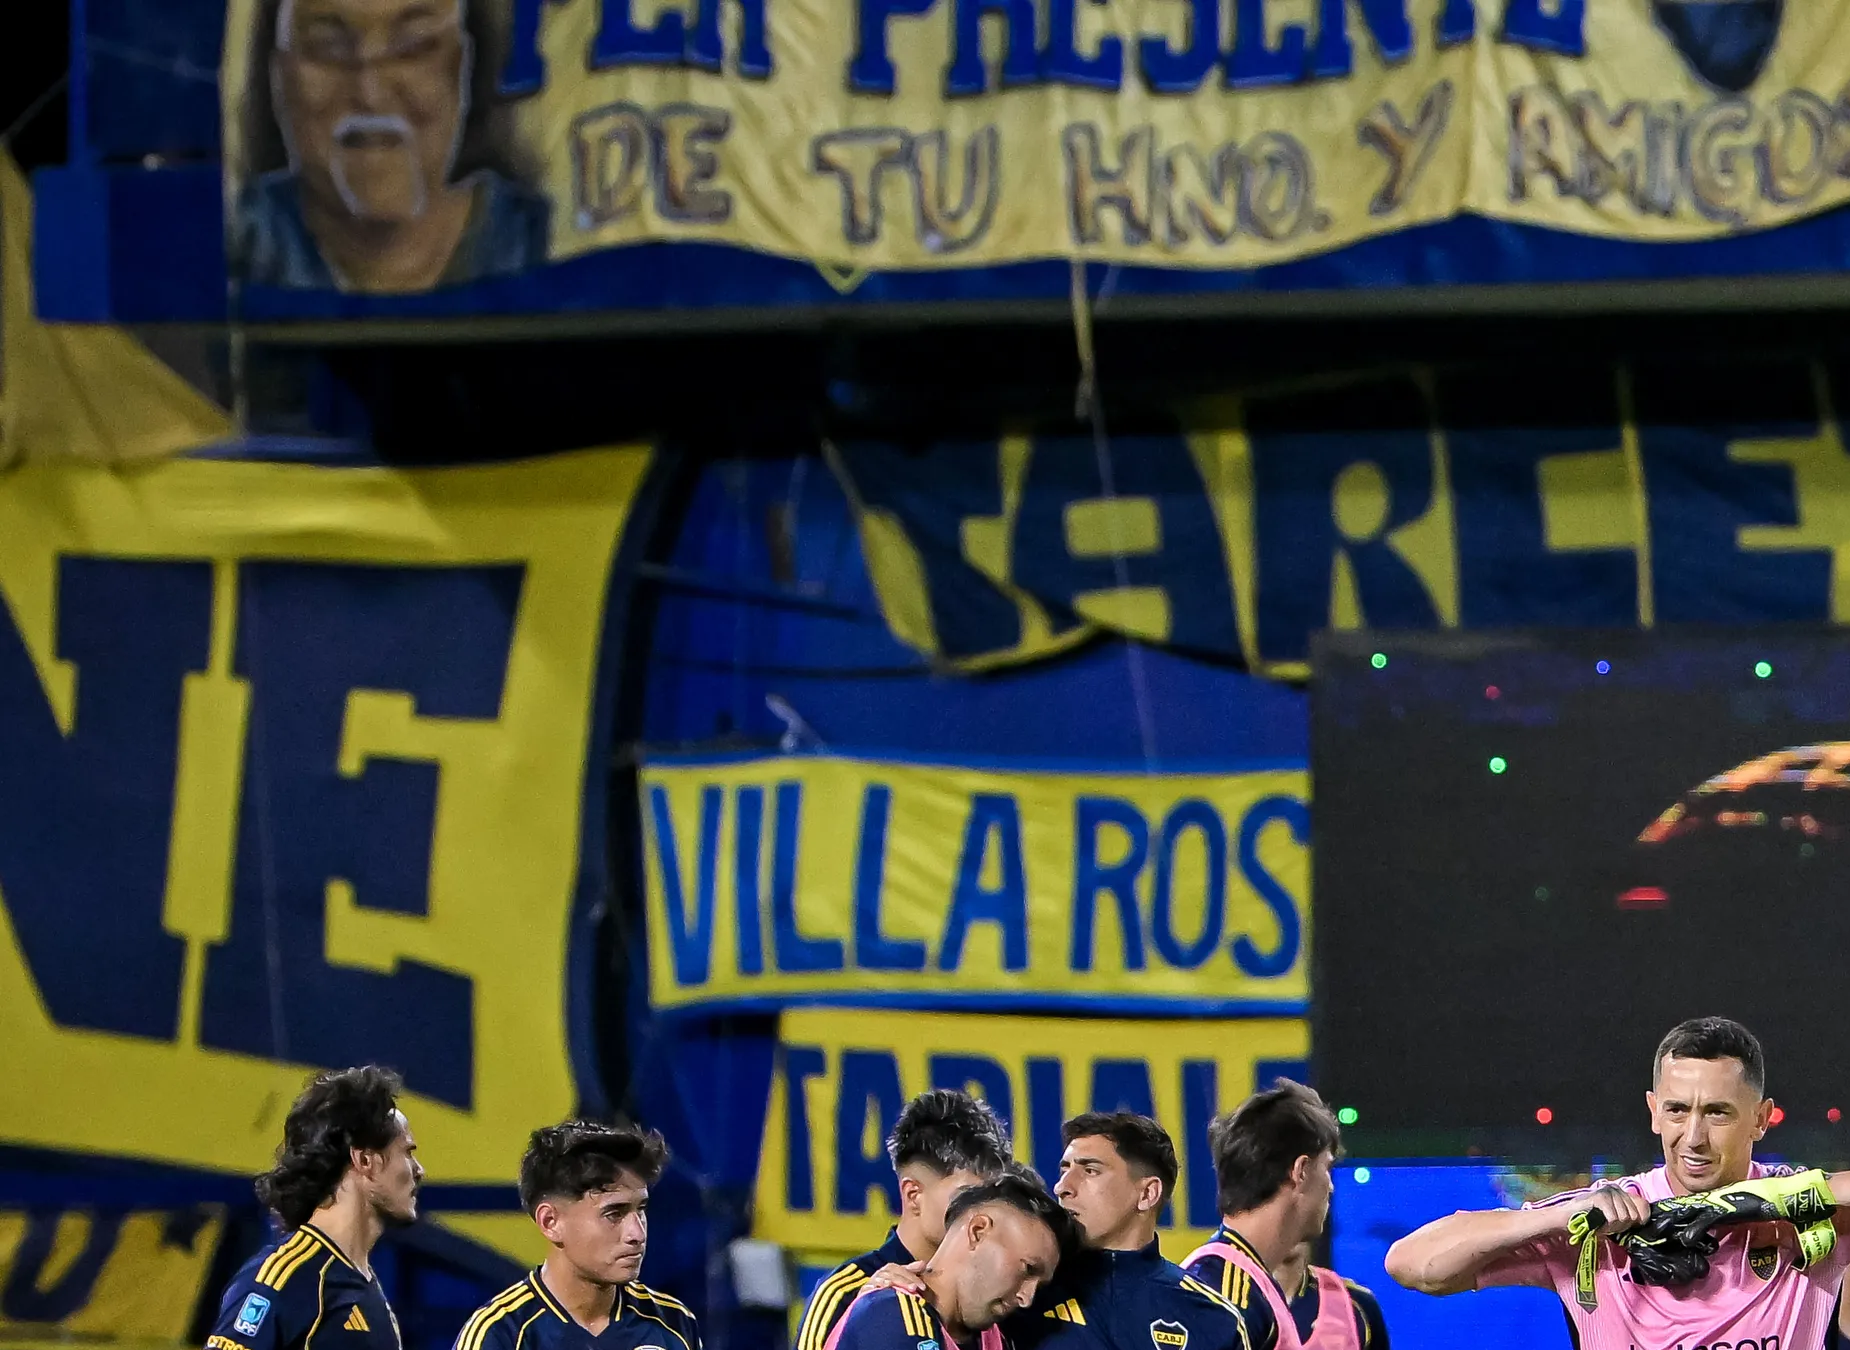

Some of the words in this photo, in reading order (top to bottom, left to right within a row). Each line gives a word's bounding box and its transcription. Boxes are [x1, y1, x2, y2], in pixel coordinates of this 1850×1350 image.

[570, 100, 736, 226] DE
[812, 124, 1002, 253] TU
[1356, 80, 1455, 216] Y
[648, 778, 1028, 988] VILLA
[1155, 1333, 1185, 1346] CABJ
